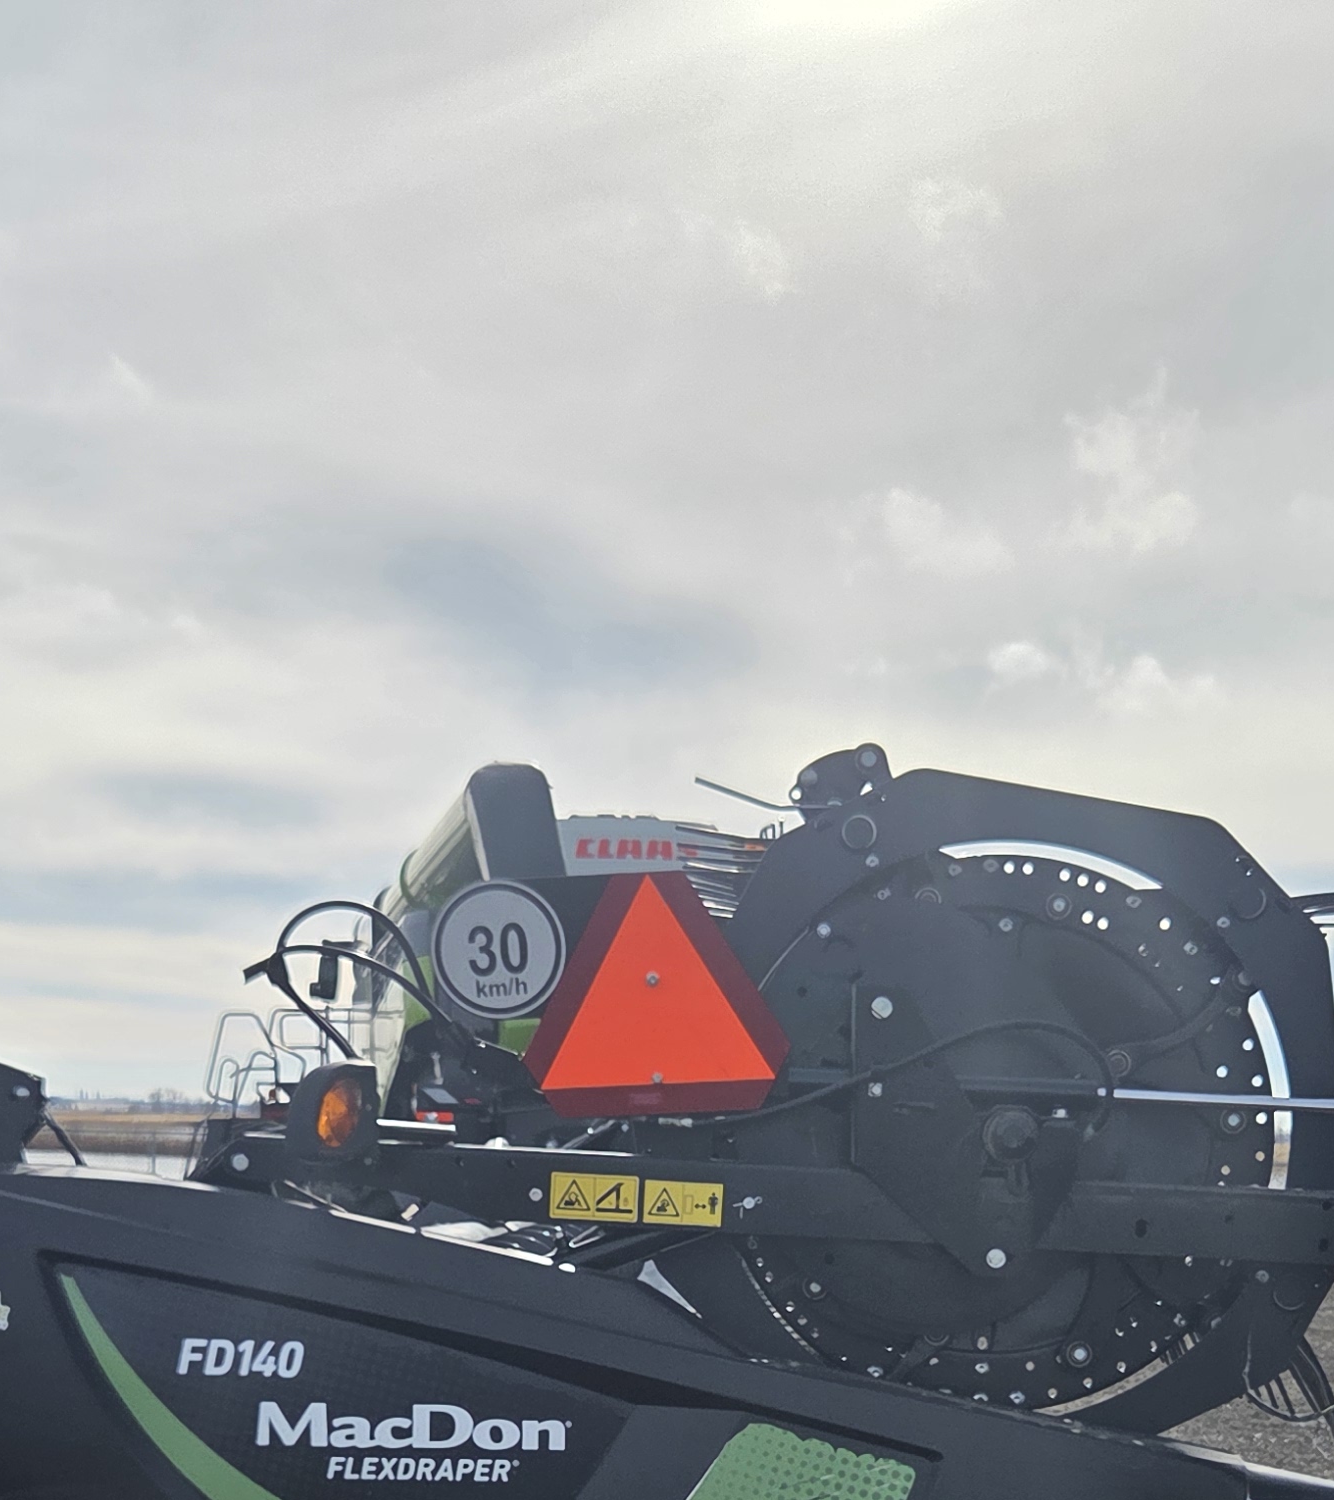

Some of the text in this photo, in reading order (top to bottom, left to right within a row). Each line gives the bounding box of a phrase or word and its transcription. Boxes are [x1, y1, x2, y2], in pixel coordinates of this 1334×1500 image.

[468, 922, 528, 977] 30
[475, 977, 528, 999] km/h
[176, 1338, 305, 1379] FD140
[255, 1401, 567, 1451] MacDon
[326, 1456, 511, 1482] FLEXDRAPER
